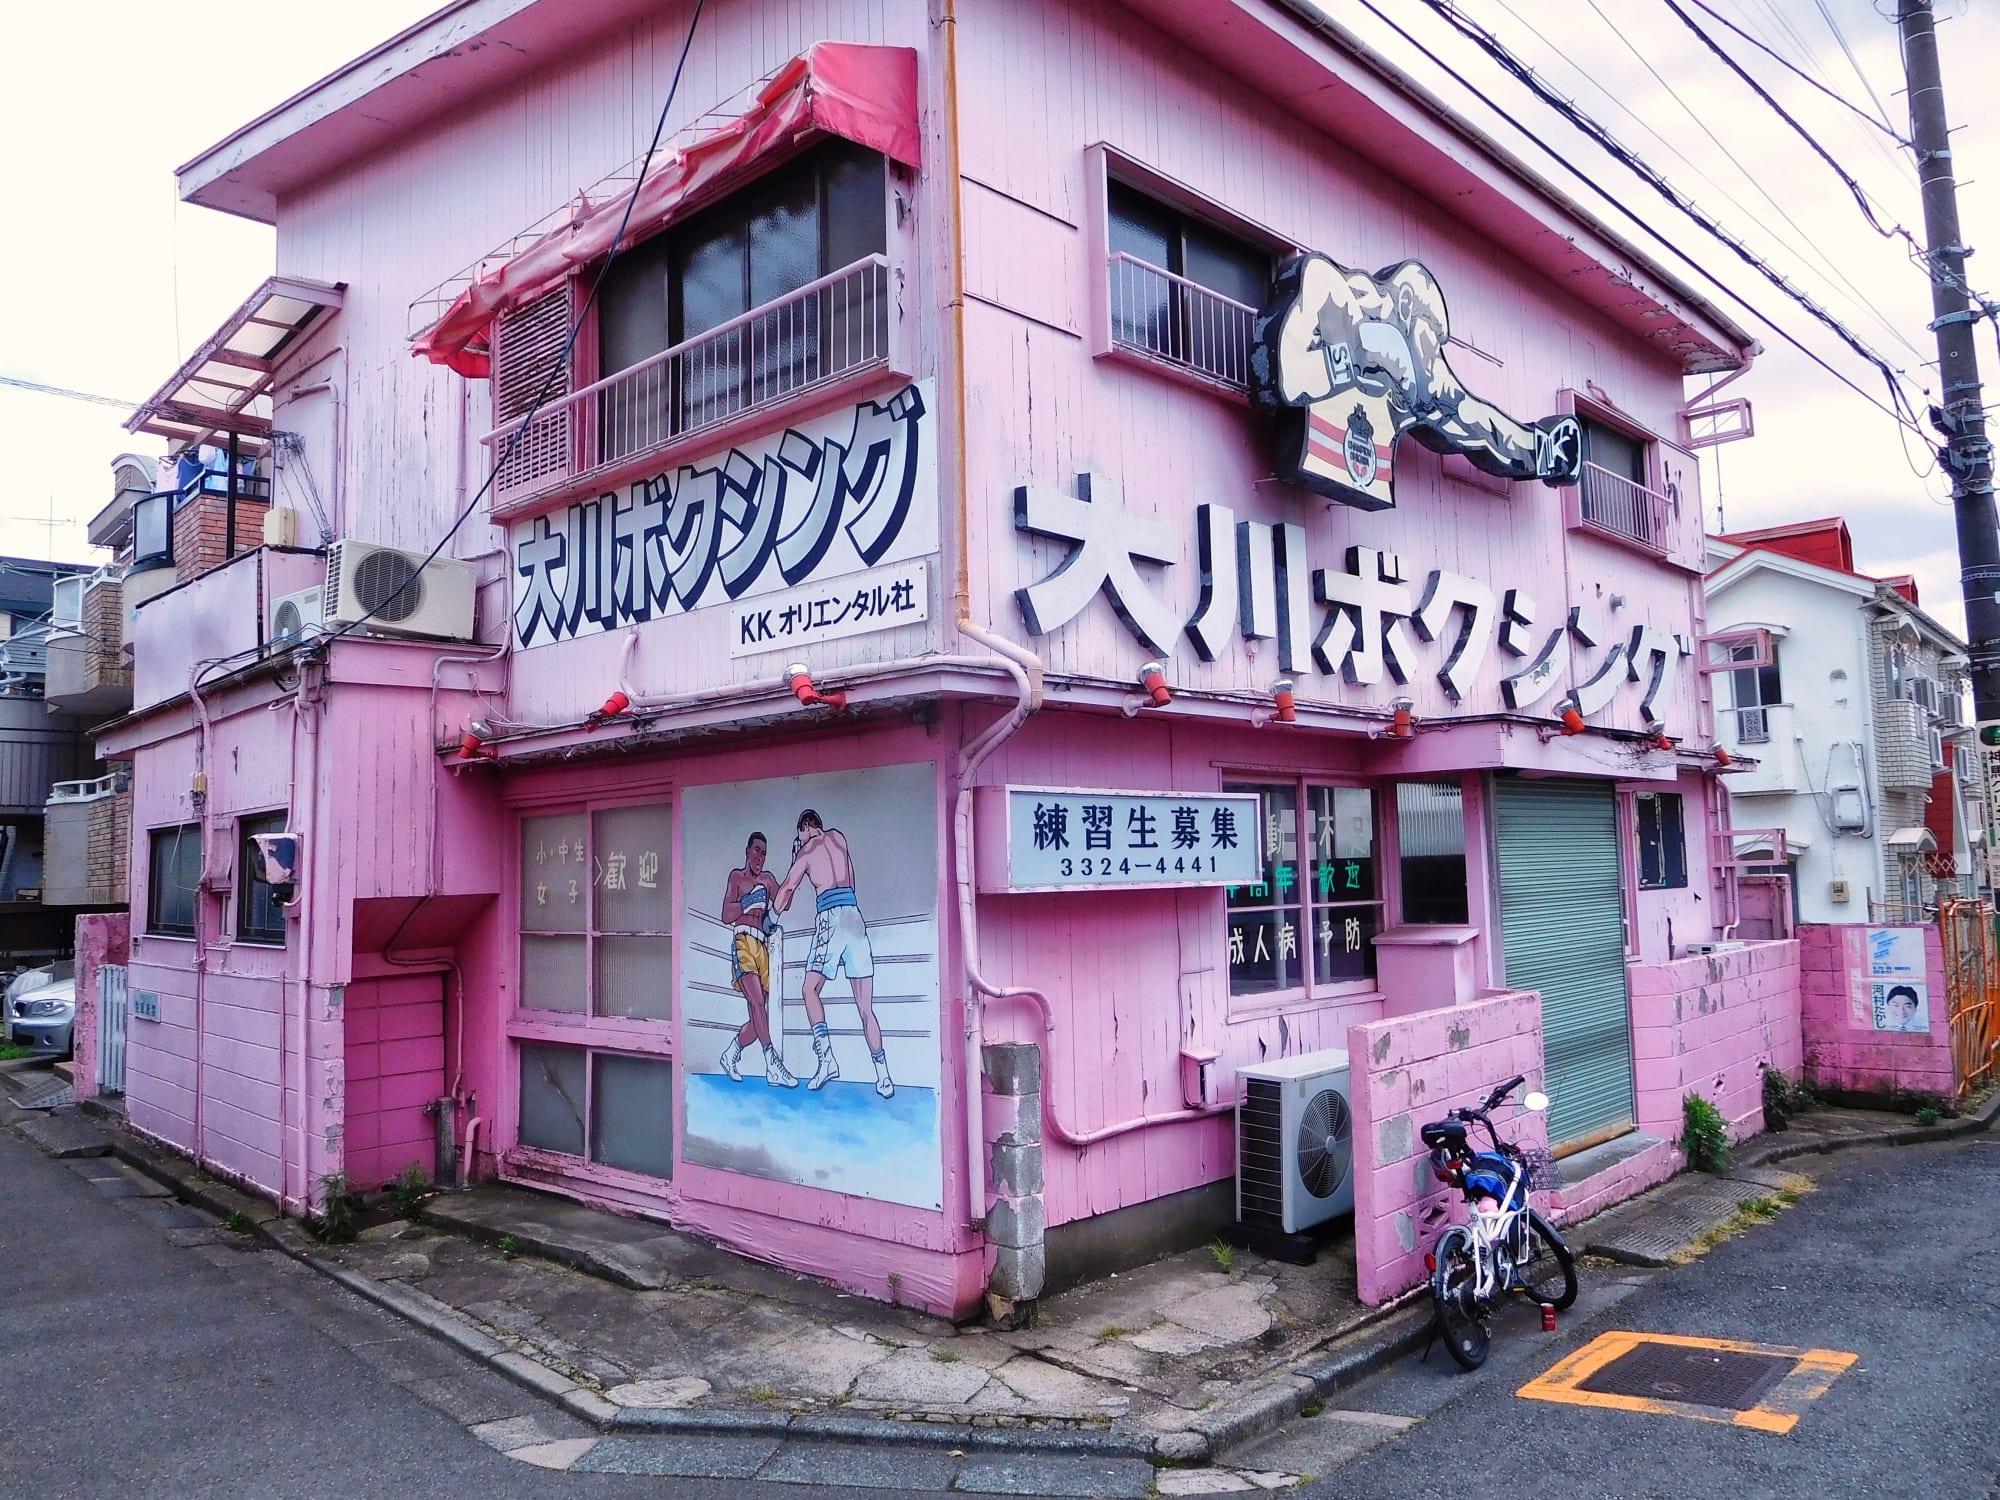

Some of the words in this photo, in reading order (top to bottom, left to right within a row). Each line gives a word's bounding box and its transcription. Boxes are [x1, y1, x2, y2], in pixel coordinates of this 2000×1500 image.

[514, 384, 926, 648] 大川ボクシング
[1013, 471, 1695, 723] 大川ボクシング
[1032, 801, 1239, 851] 練習生募集
[537, 880, 579, 905] 女子
[1229, 917, 1361, 965] 成人病予防
